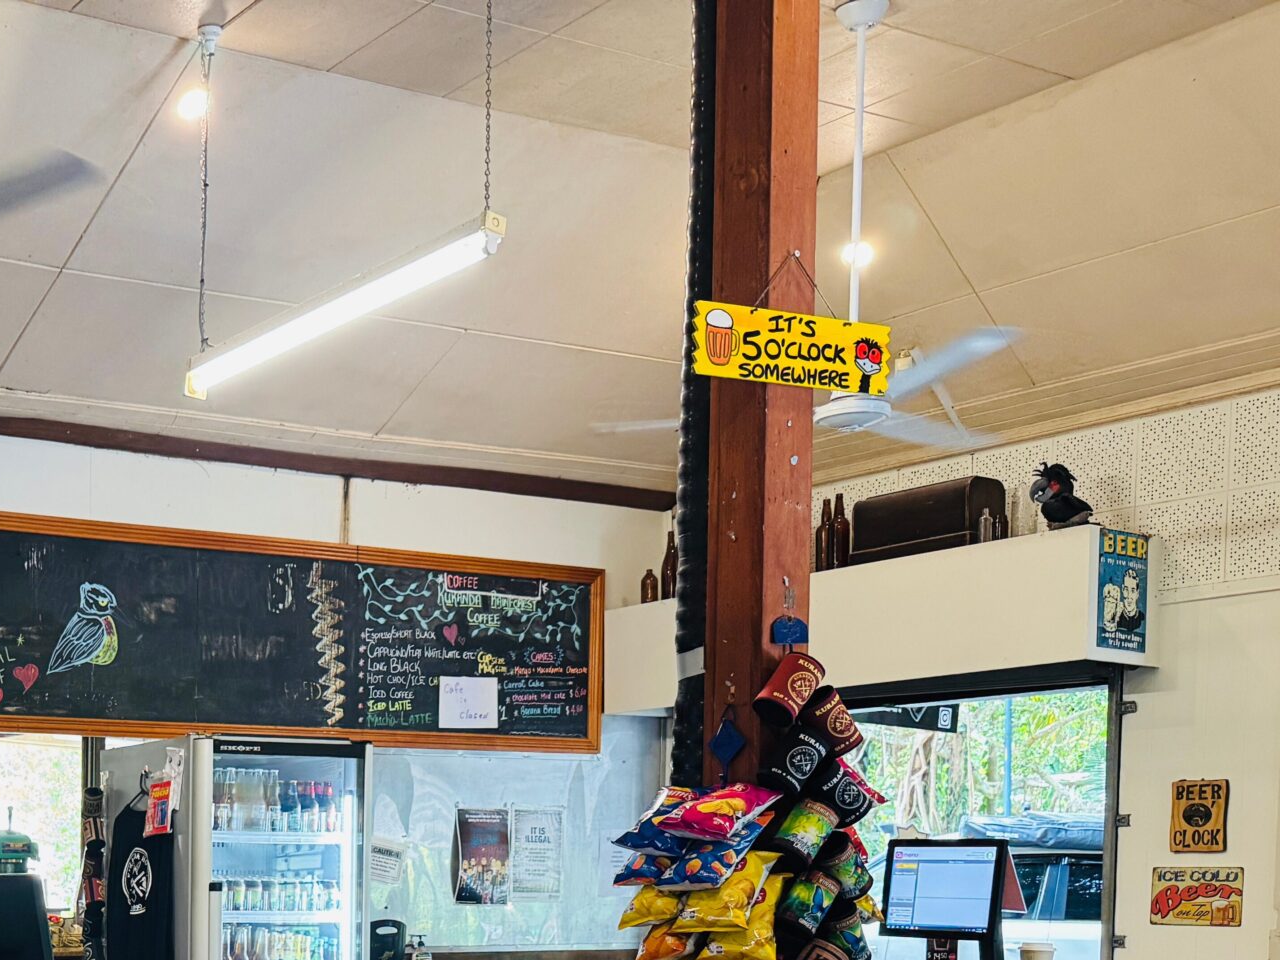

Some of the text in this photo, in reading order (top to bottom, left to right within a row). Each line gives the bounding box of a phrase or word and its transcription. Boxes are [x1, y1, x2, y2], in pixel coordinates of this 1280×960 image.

[768, 315, 817, 337] IT'S
[741, 330, 846, 365] 5 O'CLOCK
[738, 363, 850, 389] SOMEWHERE
[1103, 533, 1148, 559] BEER
[447, 574, 479, 589] COFFEE
[438, 585, 482, 613] KURANDA
[467, 607, 500, 624] COFFEE
[415, 628, 436, 640] BLACK
[368, 658, 421, 675] LONG BLACK
[366, 673, 384, 684] HOT
[390, 687, 415, 699] COFFEE
[389, 700, 412, 711] LATTE
[401, 711, 432, 725] LATTE
[1175, 784, 1222, 800] BEER
[525, 836, 551, 844] ILLEGAL
[1173, 829, 1220, 848] CLOCK
[1157, 869, 1239, 882] ICE COLD
[1151, 883, 1243, 919] Beer
[1176, 904, 1211, 922] on Tap
